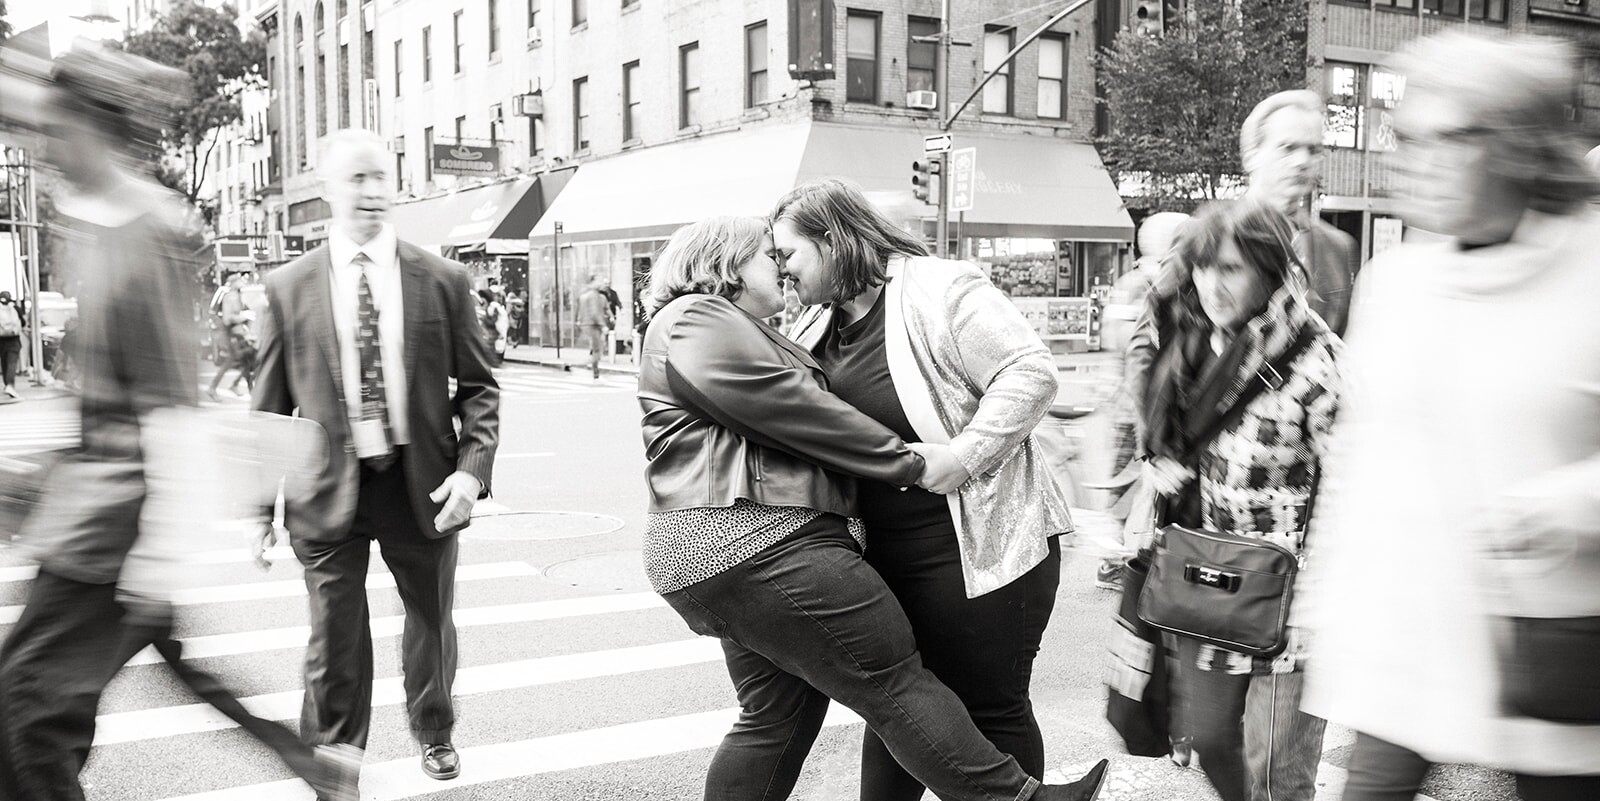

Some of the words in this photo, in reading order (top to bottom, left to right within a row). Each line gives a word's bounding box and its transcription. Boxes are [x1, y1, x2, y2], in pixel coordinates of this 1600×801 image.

[1371, 71, 1407, 100] NEW
[439, 158, 494, 171] SOMBRERO
[974, 180, 1022, 194] OCERY
